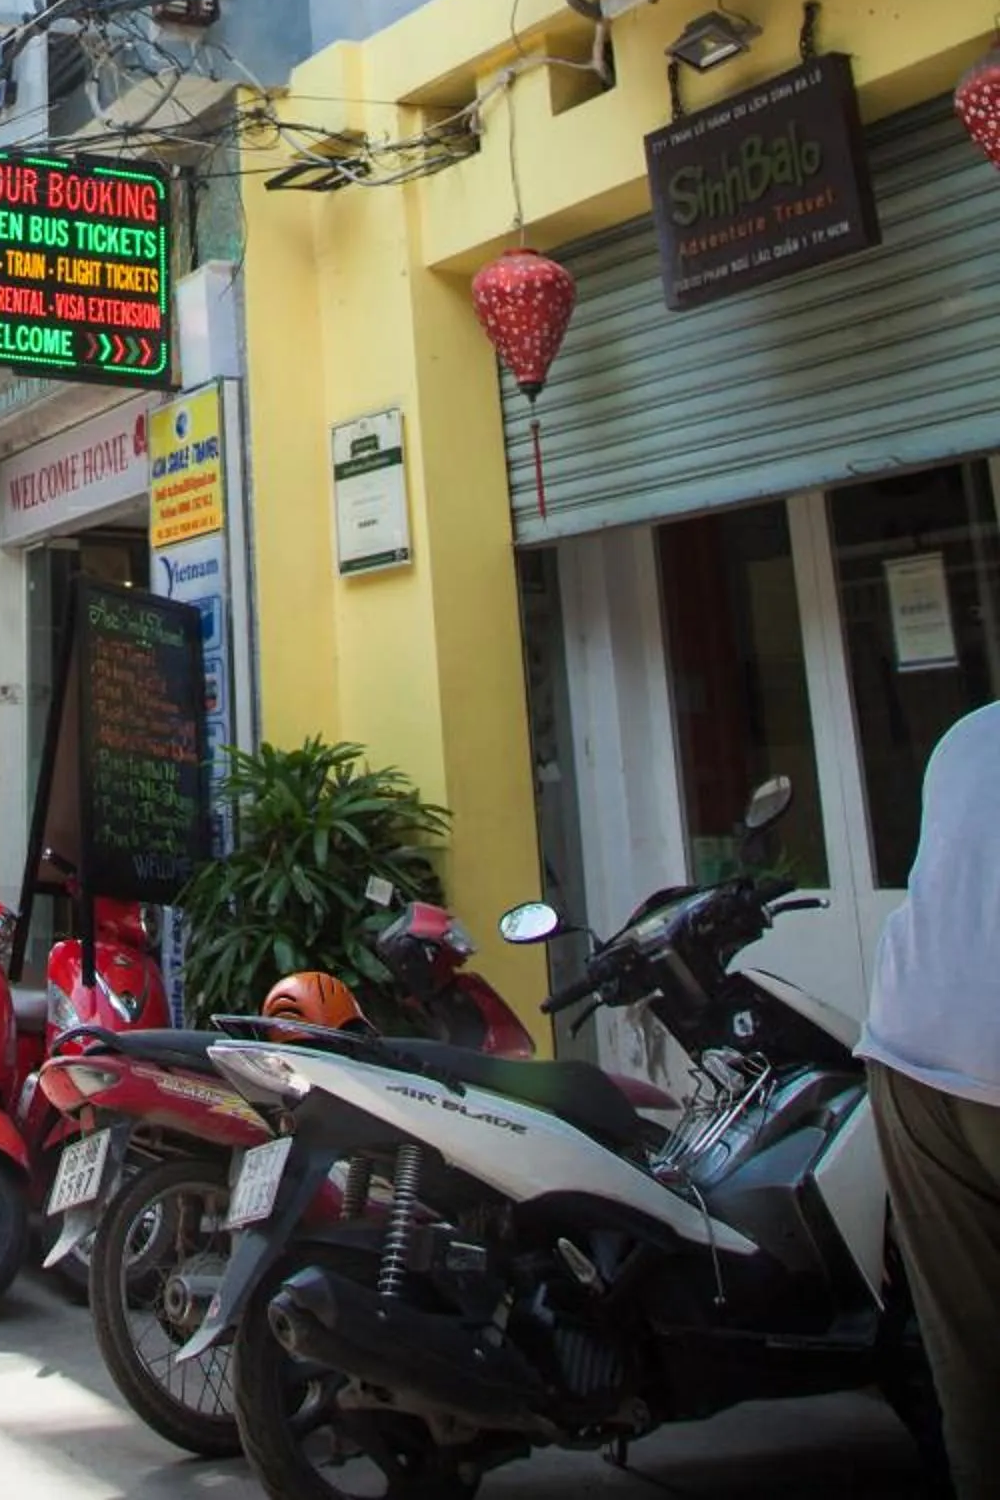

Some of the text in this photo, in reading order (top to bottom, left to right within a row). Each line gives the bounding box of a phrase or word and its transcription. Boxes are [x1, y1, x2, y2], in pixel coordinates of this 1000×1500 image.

[47, 172, 157, 221] BOOKING
[669, 118, 820, 226] SinhBalo
[29, 215, 69, 248] BUS
[74, 221, 157, 258] TICKETS
[678, 188, 835, 256] Adventure Travel
[6, 249, 46, 280] TRAIN
[56, 256, 102, 287] FLIGHT
[105, 263, 159, 293] TICKETS
[55, 292, 86, 321] VISA
[88, 297, 161, 329] EXTENSION
[9, 432, 129, 512] WELCOME HOME
[386, 1085, 528, 1134] AIR BLADE
